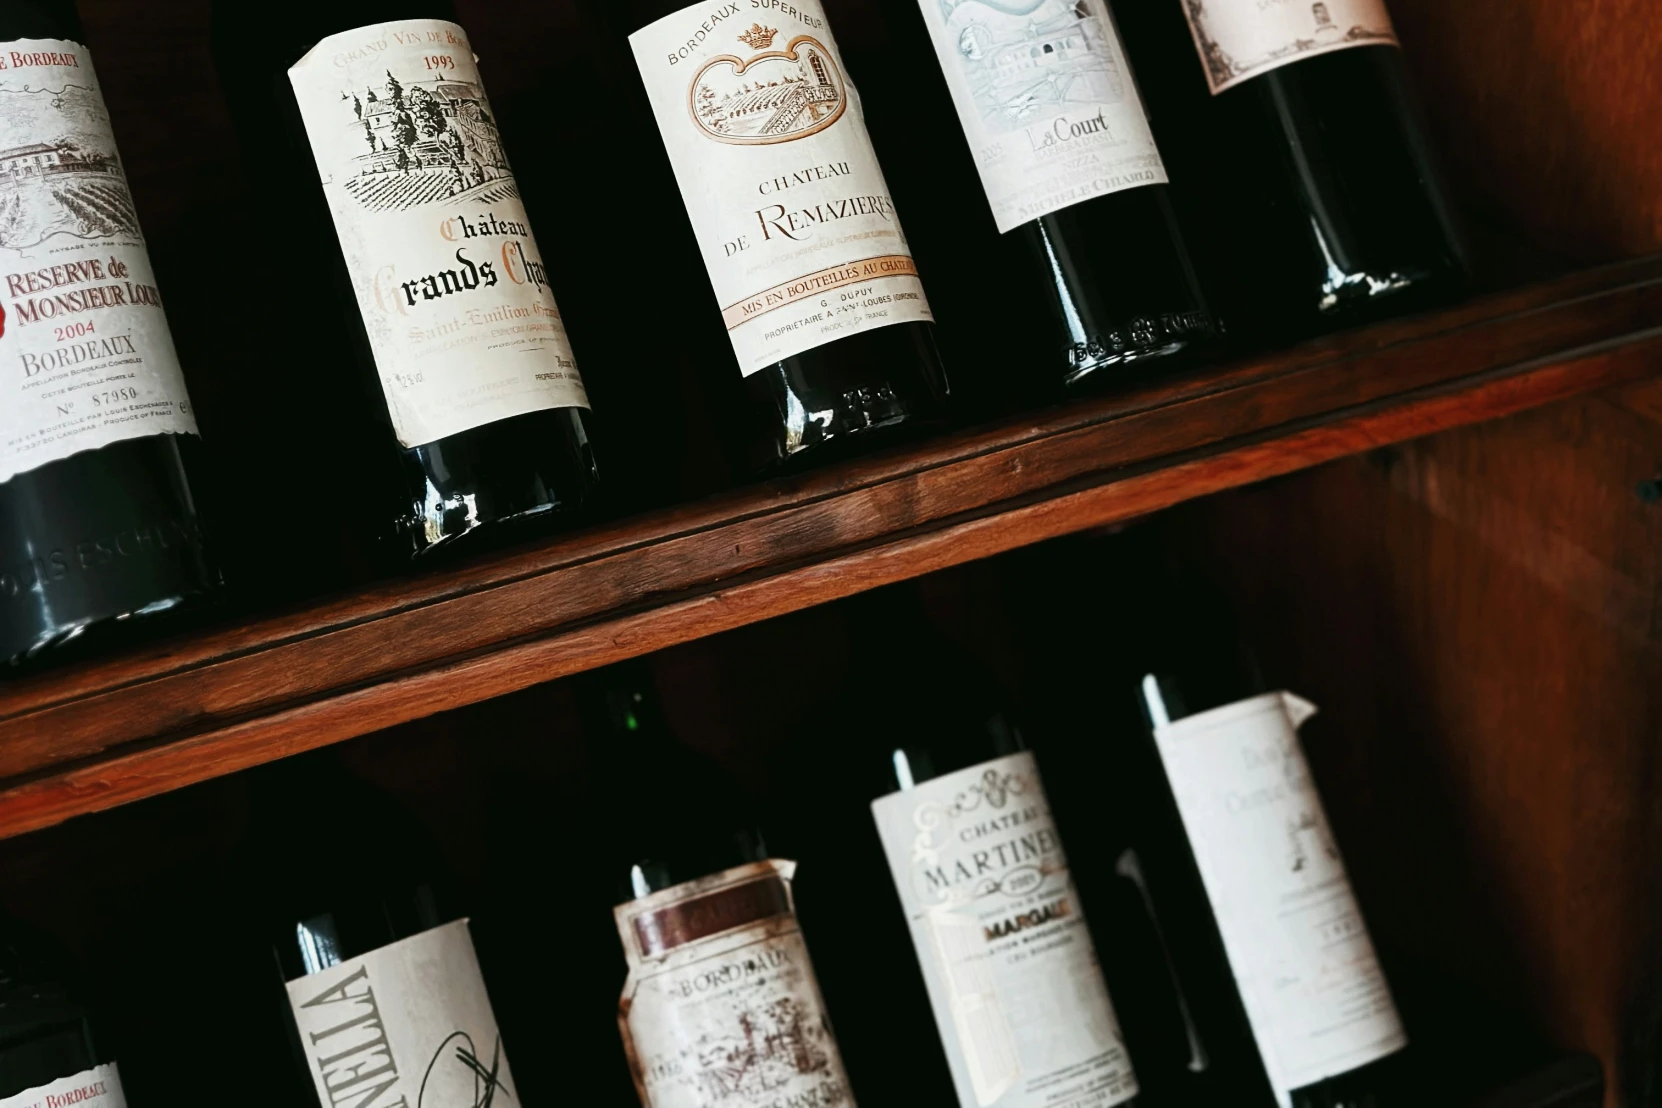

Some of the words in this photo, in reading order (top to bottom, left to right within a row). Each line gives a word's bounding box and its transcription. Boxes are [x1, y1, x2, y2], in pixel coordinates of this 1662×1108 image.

[333, 38, 388, 68] GRAND
[393, 30, 421, 45] VIN
[426, 31, 442, 42] DE
[445, 29, 465, 46] BOR
[667, 2, 741, 66] BORDEAUX
[9, 51, 79, 68] BORDEAUX
[423, 55, 456, 71] 1993
[758, 161, 851, 196] CHATEAU
[1017, 183, 1092, 219] MICHELE
[439, 212, 528, 242] Château
[724, 235, 751, 258] DE
[754, 195, 894, 242] REMAZIERES
[5, 258, 107, 299] RESERVE
[108, 255, 130, 280] de
[374, 247, 499, 317] Grands
[741, 300, 764, 317] MIS
[766, 290, 784, 306] EN
[788, 266, 860, 298] BOUTEILLES
[863, 261, 878, 276] AU
[840, 286, 873, 302] DUPUY
[12, 284, 130, 327] MONSIEUR
[53, 319, 96, 342] 2004
[19, 334, 137, 378] BORDEAUX
[21, 372, 70, 391] APPELLATION
[70, 363, 108, 376] BORDEAUX
[41, 388, 67, 400] CETTE
[67, 379, 105, 392] BOUTEILLE
[39, 417, 85, 436] BOUTEILLE
[87, 412, 102, 421] PAR
[104, 406, 128, 417] LOUIS
[104, 414, 139, 426] PRODUCE
[922, 827, 1058, 894] MARTINE
